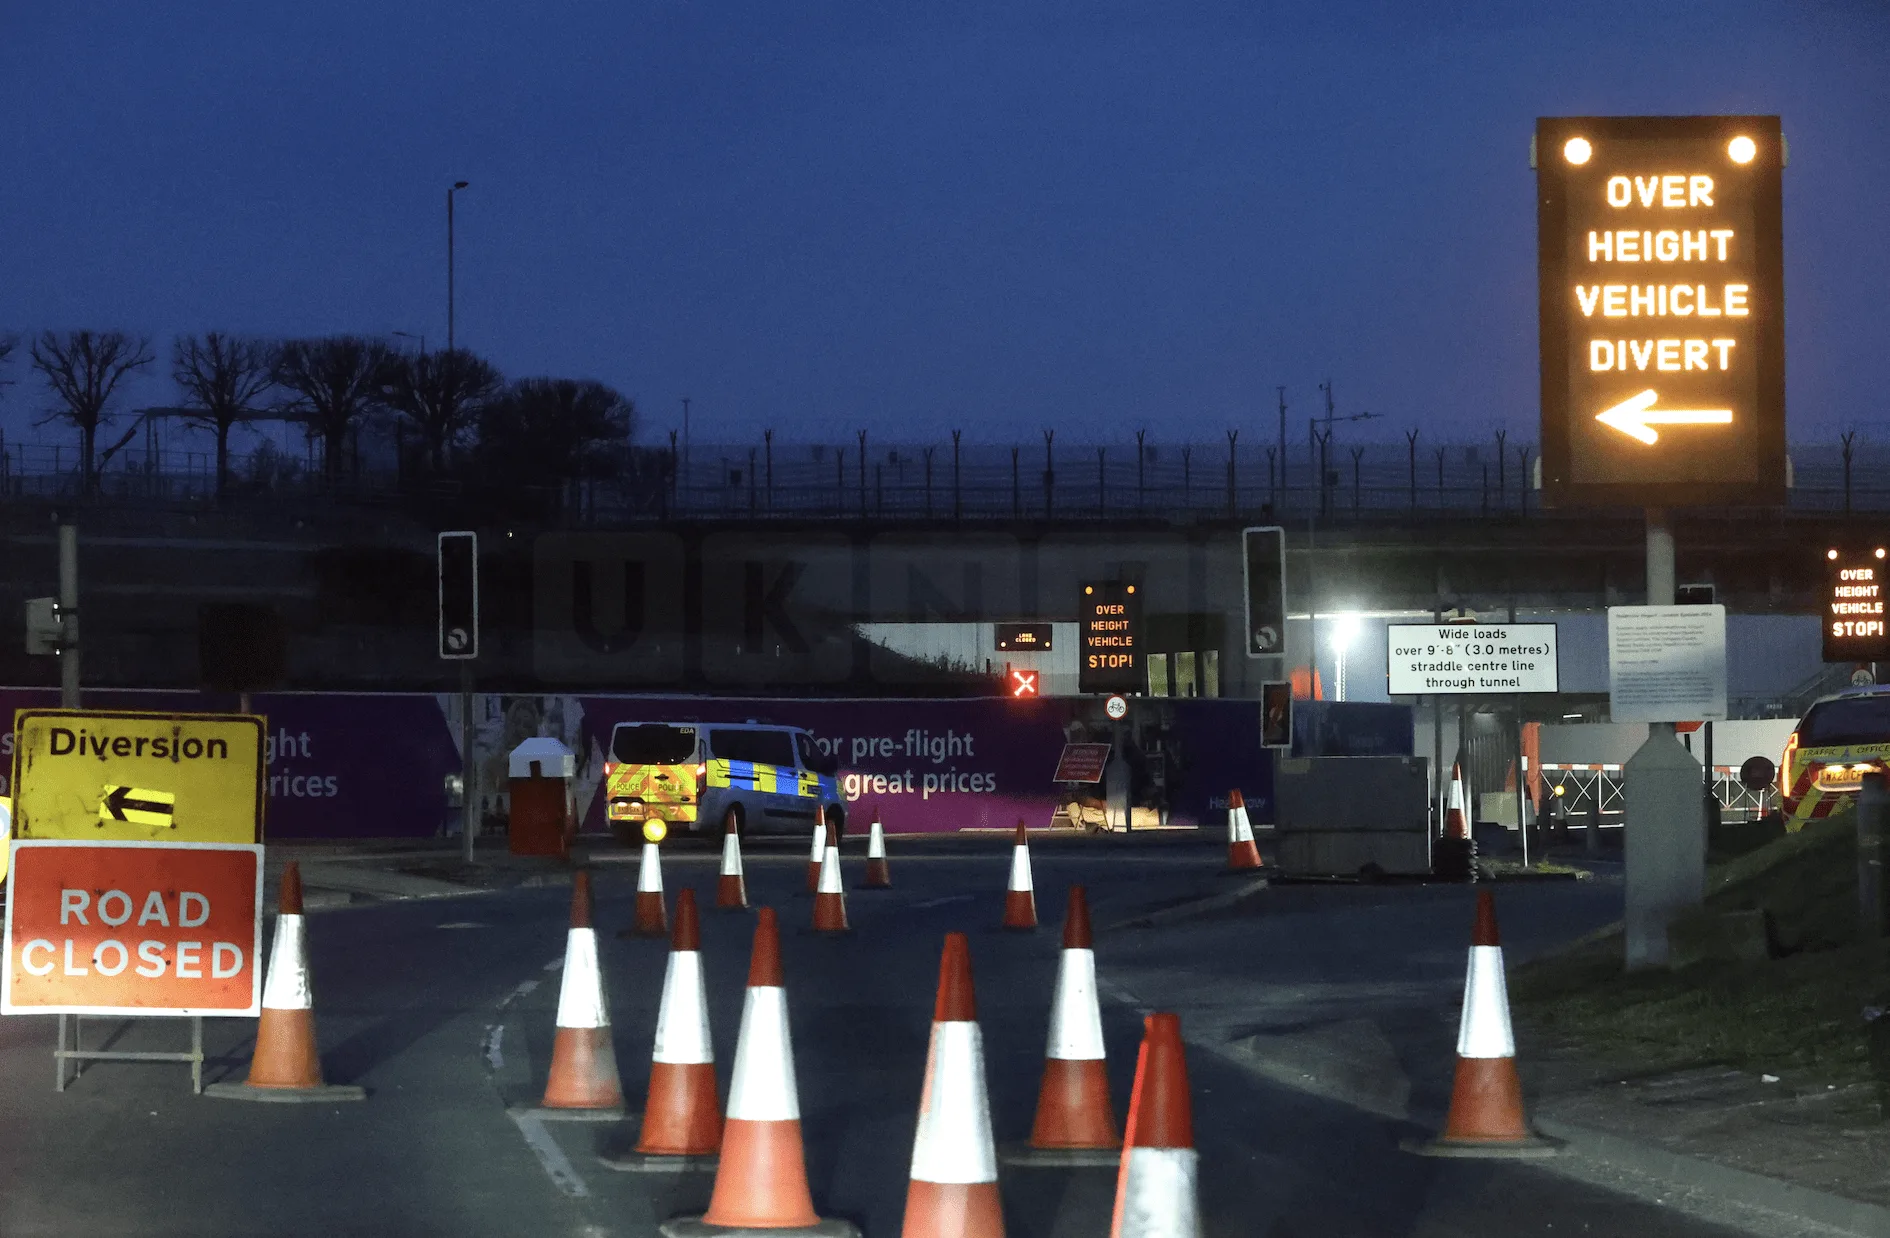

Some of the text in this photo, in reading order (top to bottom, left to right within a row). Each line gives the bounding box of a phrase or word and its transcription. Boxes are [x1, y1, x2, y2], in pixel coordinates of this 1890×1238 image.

[1607, 174, 1715, 208] OVER
[1587, 229, 1735, 262] HEIGHT
[1574, 284, 1750, 318] VEHICLE
[1590, 338, 1737, 372] DIVERT
[1839, 568, 1874, 582] OVER
[1834, 584, 1880, 598] HEIGHT
[1095, 604, 1125, 616] OVER
[1830, 601, 1884, 615] VEHICLE
[1090, 620, 1129, 631] HEIGHT
[1438, 628, 1507, 640] Wide loads
[1087, 636, 1133, 647] VEHICLE
[1395, 646, 1422, 656] over
[1088, 654, 1133, 669] STOP!
[1410, 660, 1535, 672] straddle centre line
[1426, 676, 1520, 689] through tunnel
[50, 728, 228, 760] Diversion
[266, 728, 312, 765] ght
[851, 729, 974, 763] pre-flight
[1803, 748, 1837, 757] TRAFFIC
[265, 768, 338, 798] rices
[616, 783, 640, 791] POLICE
[844, 769, 997, 802] great prices
[59, 888, 211, 928] ROAD
[20, 938, 245, 979] CLOSED
